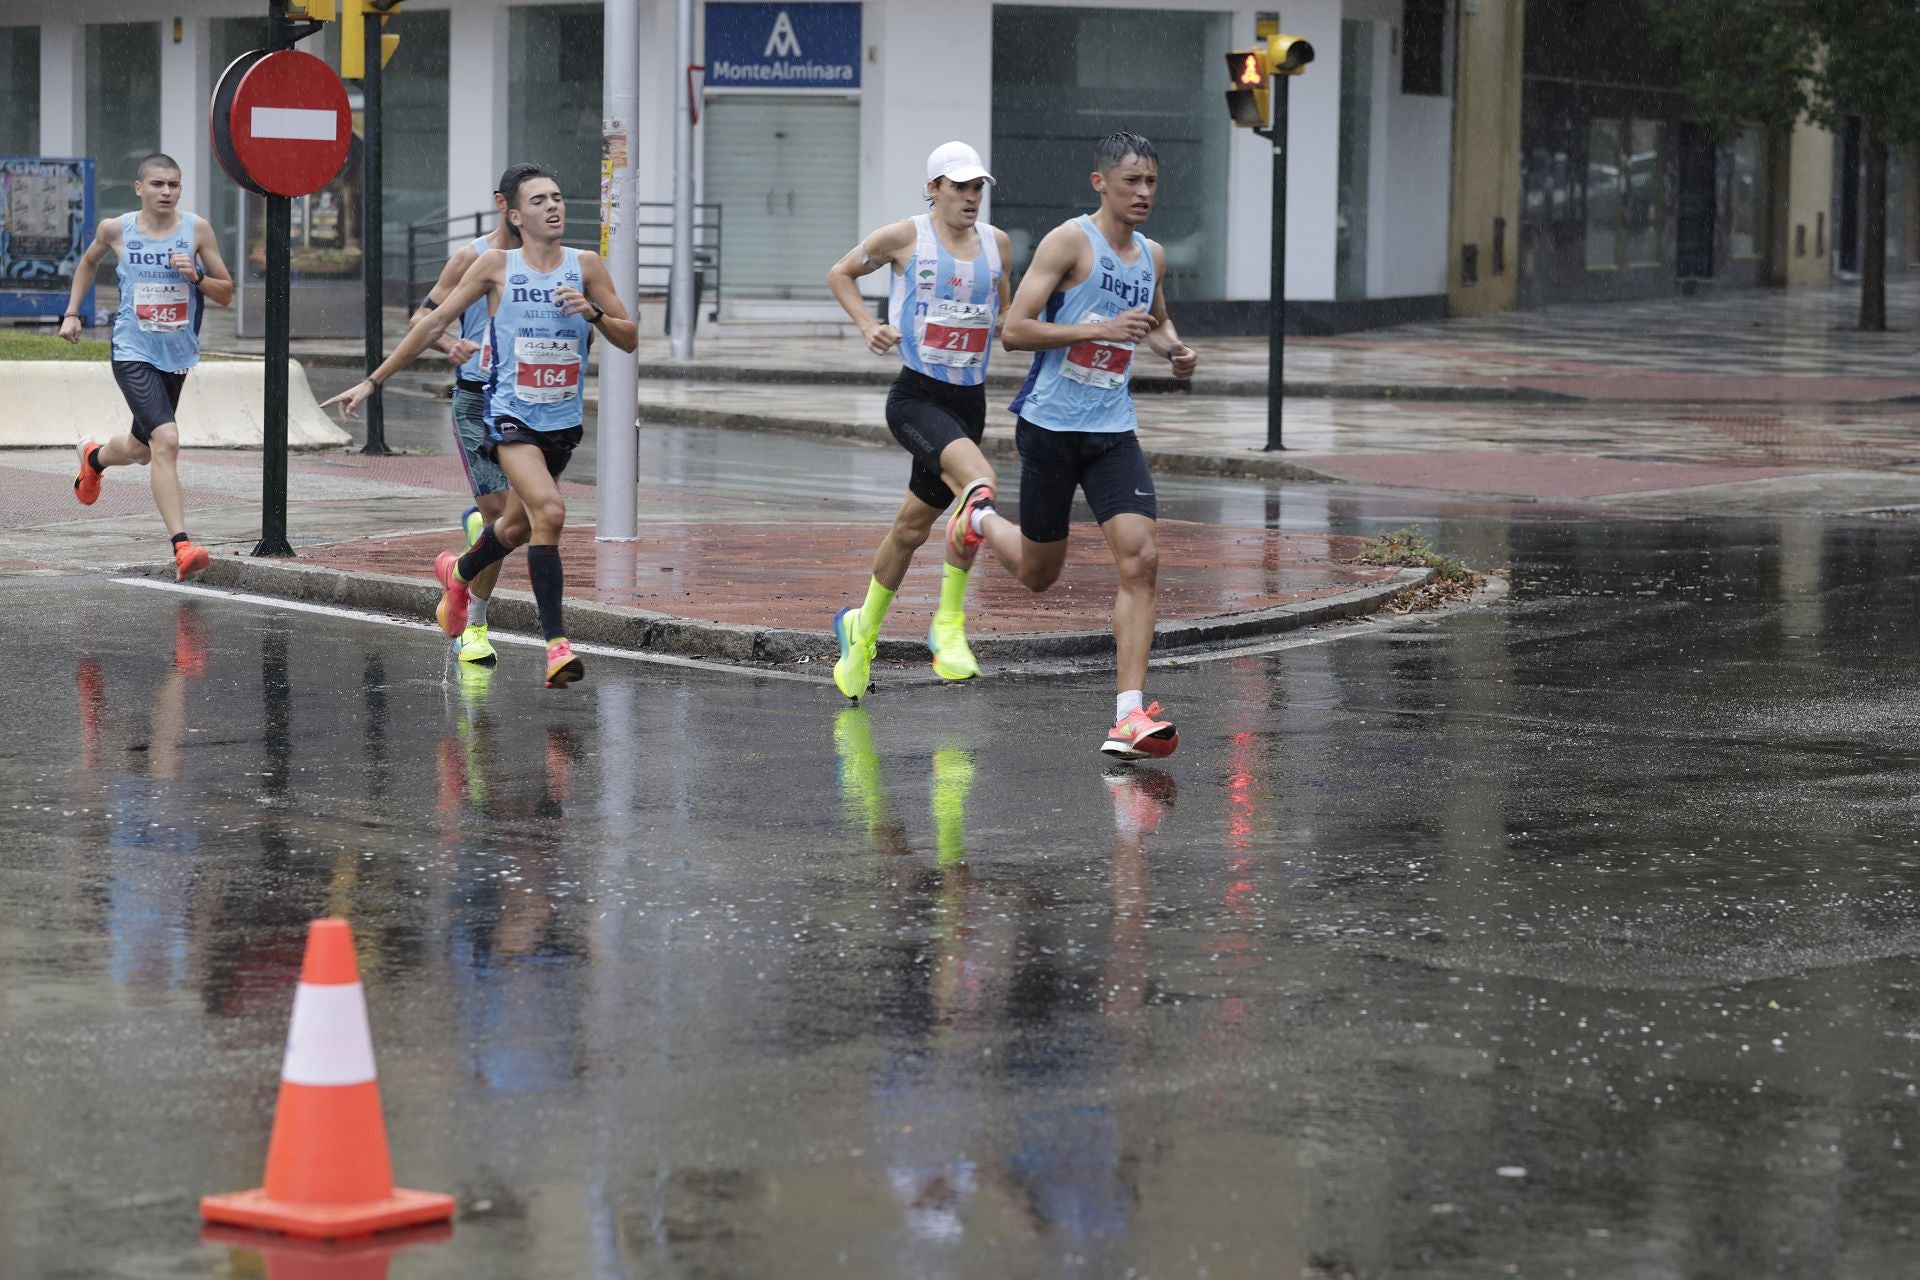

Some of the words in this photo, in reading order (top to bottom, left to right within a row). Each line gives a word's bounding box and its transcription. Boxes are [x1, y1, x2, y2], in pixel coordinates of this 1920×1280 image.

[129, 248, 173, 269] nerj
[1099, 272, 1150, 308] nerja
[149, 308, 177, 322] 345
[945, 331, 971, 351] 21
[1090, 348, 1113, 369] 52
[532, 368, 568, 387] 164
